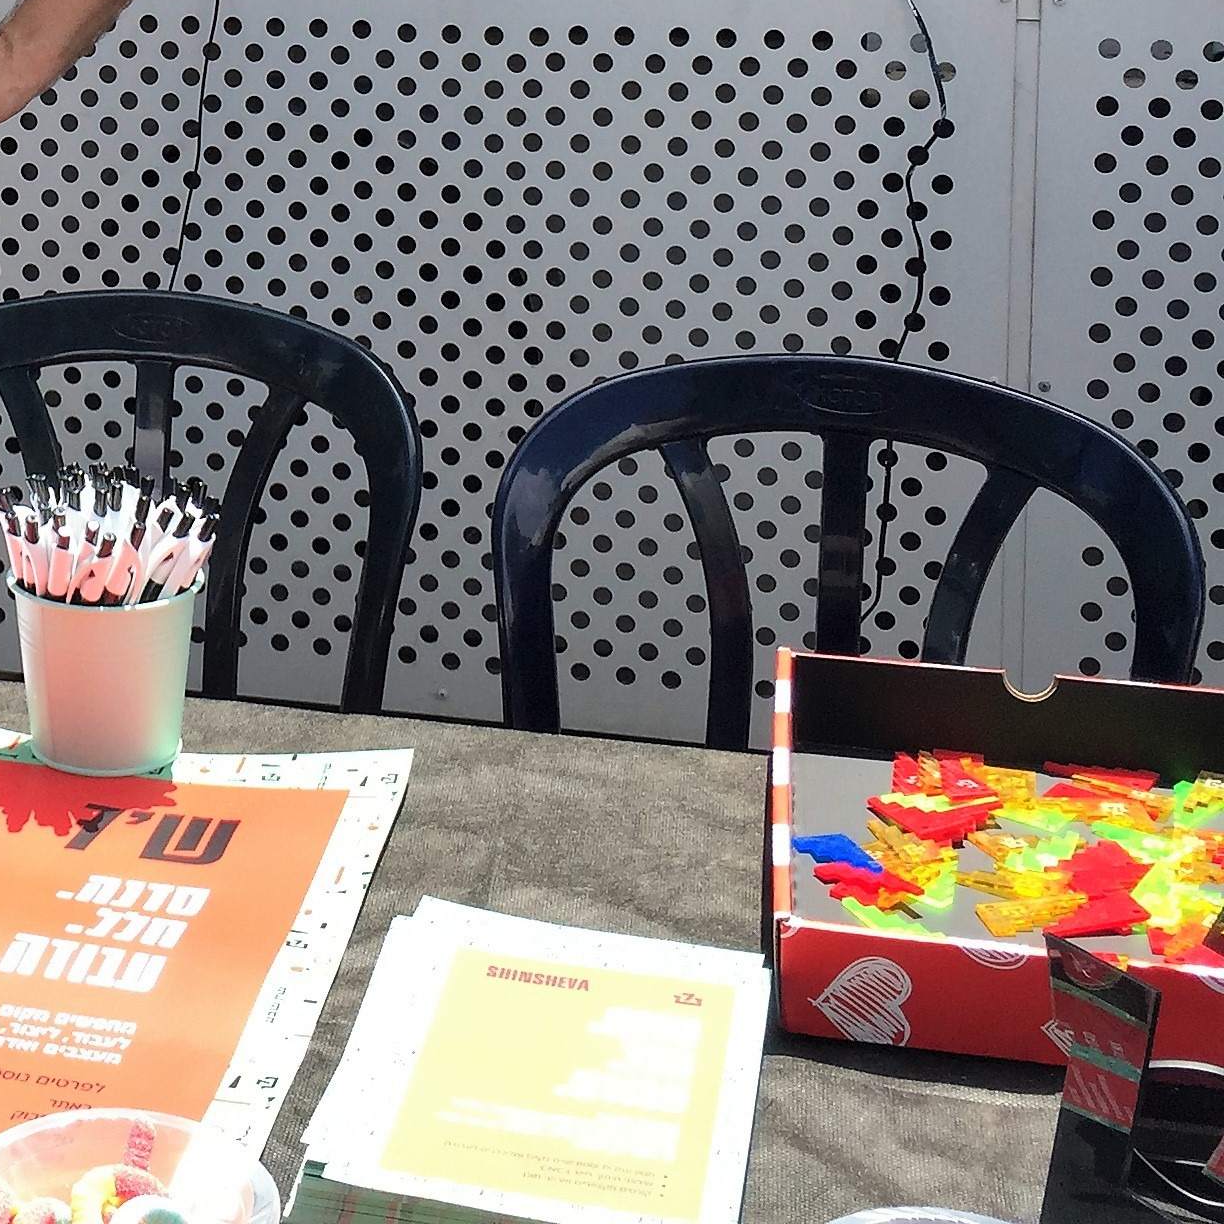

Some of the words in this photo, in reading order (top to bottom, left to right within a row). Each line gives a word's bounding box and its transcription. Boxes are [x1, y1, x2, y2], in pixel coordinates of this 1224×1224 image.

[55, 874, 211, 917] סדנה.
[64, 906, 189, 950] חלל.
[486, 965, 590, 992] SHINSHEVA
[36, 1075, 106, 1094] לפרטים
